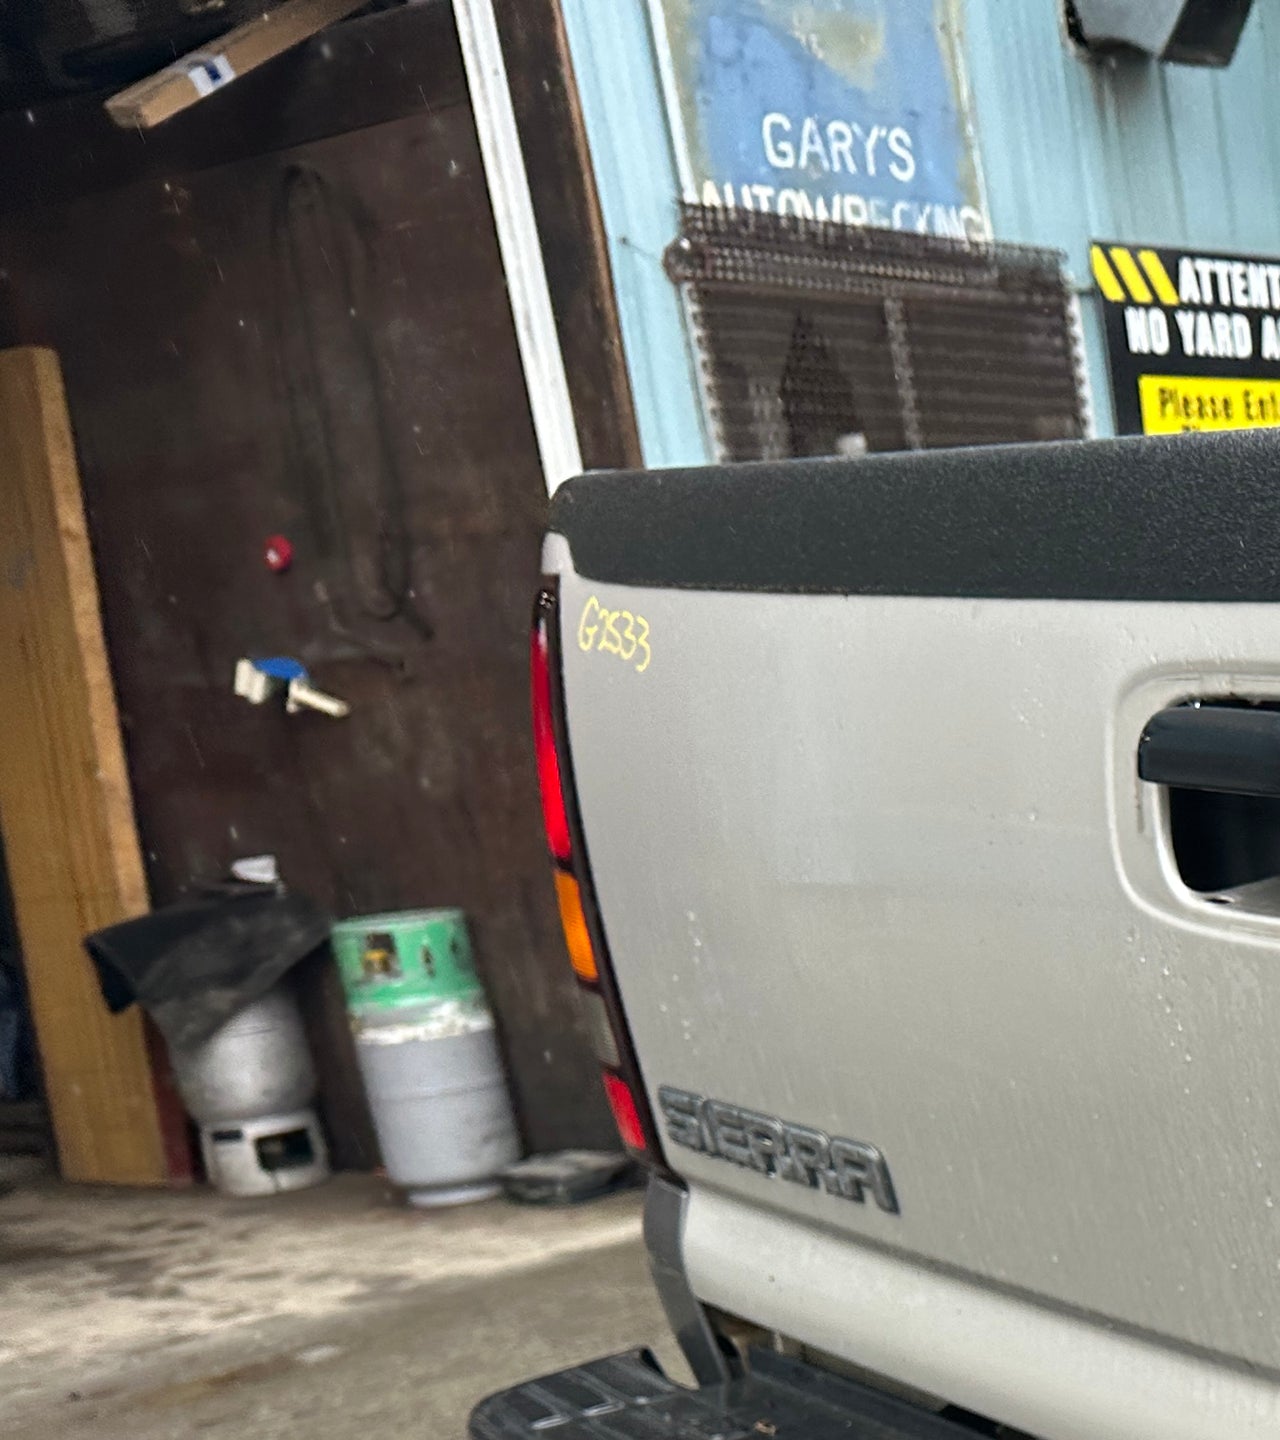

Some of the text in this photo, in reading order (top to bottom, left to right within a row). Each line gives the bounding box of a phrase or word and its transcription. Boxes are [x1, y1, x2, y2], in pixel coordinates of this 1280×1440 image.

[762, 112, 917, 182] GARY'S
[1123, 305, 1171, 355] NO
[1174, 309, 1253, 360] YARD
[1158, 386, 1234, 421] Please
[578, 595, 651, 672] G2533
[658, 1084, 902, 1216] SIERRA
